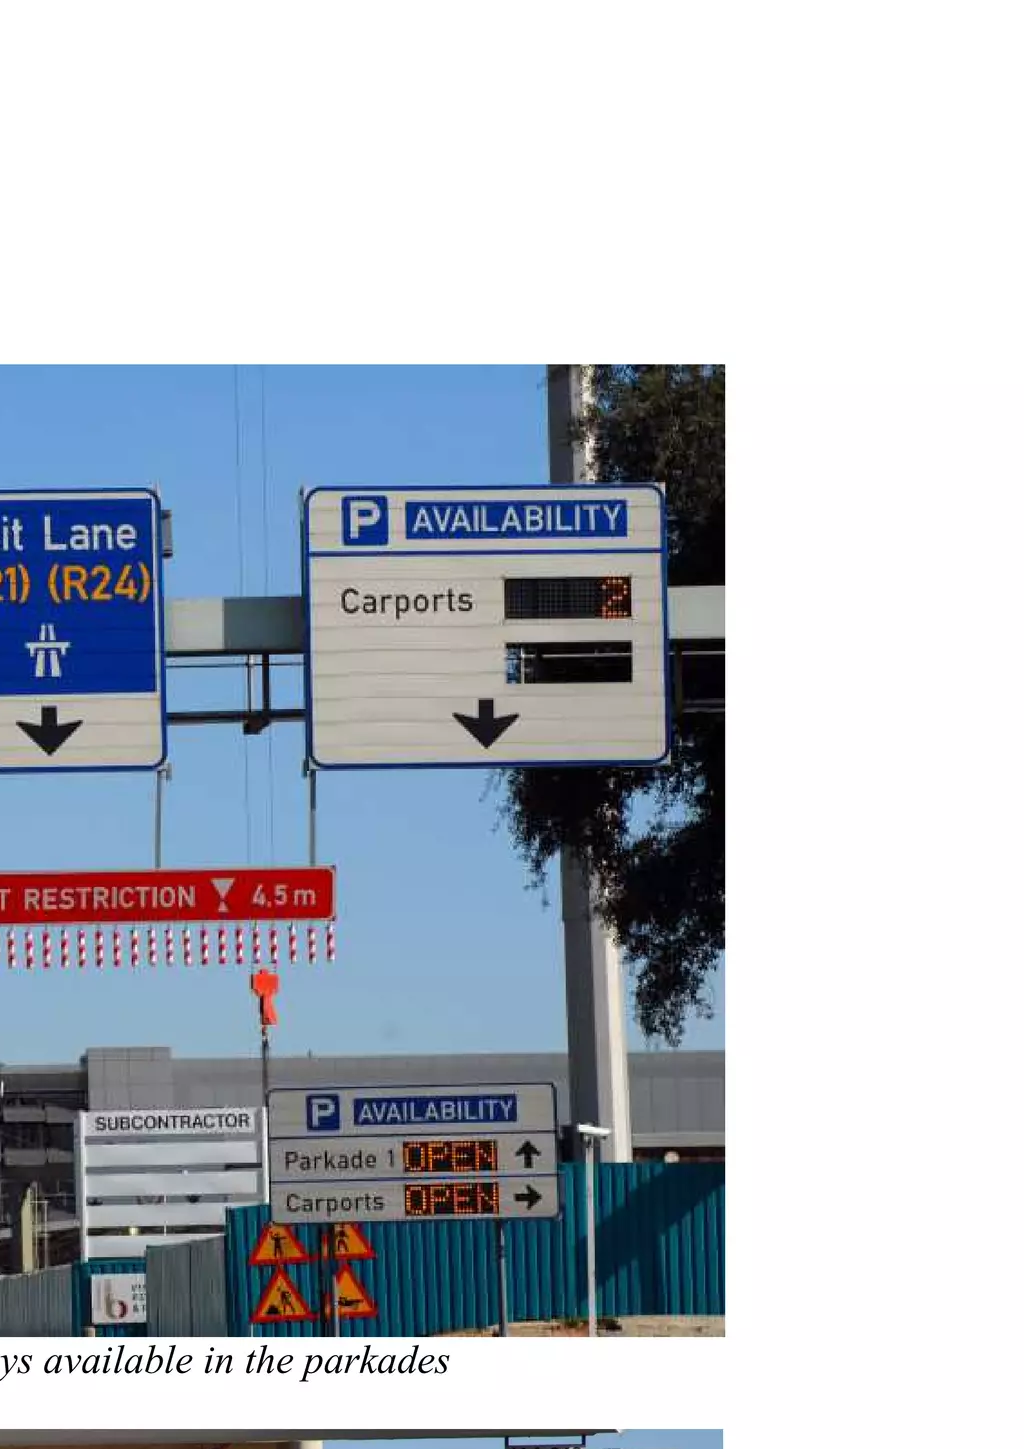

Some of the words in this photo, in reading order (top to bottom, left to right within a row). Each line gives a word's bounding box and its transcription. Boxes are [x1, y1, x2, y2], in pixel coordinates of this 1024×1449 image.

[44, 516, 137, 551] Lane
[350, 501, 380, 539] P
[413, 504, 623, 533] AVAILABILITY
[49, 562, 150, 602] (R24)
[341, 588, 474, 620] Carports
[601, 577, 629, 619] 2
[24, 885, 196, 910] RESTRICTION
[95, 1113, 250, 1131] SUBCONTRACTOR
[312, 1099, 336, 1127] P
[358, 1099, 513, 1122] AVAILABILITY
[284, 1150, 376, 1171] Parkade
[388, 1150, 394, 1167] 1
[404, 1142, 497, 1171] OPEN
[286, 1192, 384, 1215] Carports
[405, 1185, 499, 1215] OPEN
